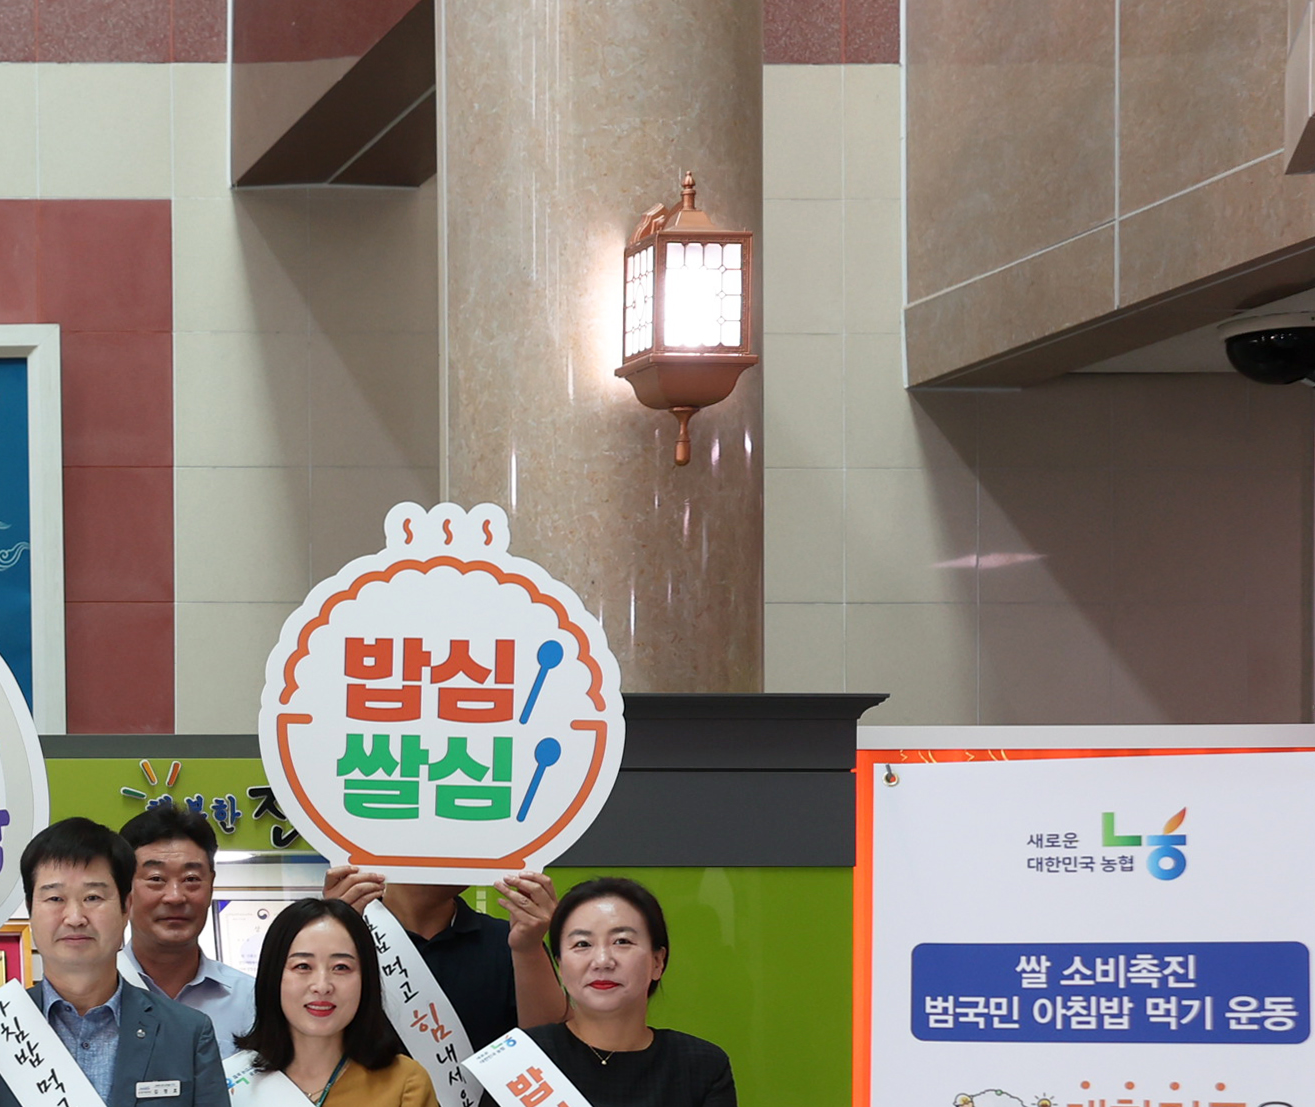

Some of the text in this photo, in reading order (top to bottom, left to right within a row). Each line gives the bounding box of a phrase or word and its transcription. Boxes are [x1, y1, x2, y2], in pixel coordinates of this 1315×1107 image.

[344, 637, 516, 724] 밥심
[336, 732, 515, 822] 쌀심
[1027, 832, 1079, 850] 새로운
[1027, 855, 1135, 873] 대한민국 농협
[1015, 954, 1196, 989] 쌀 소비촉진
[381, 956, 453, 1043] 먹고 힘
[925, 996, 1298, 1030] 범국민 아침밥 먹기 운동
